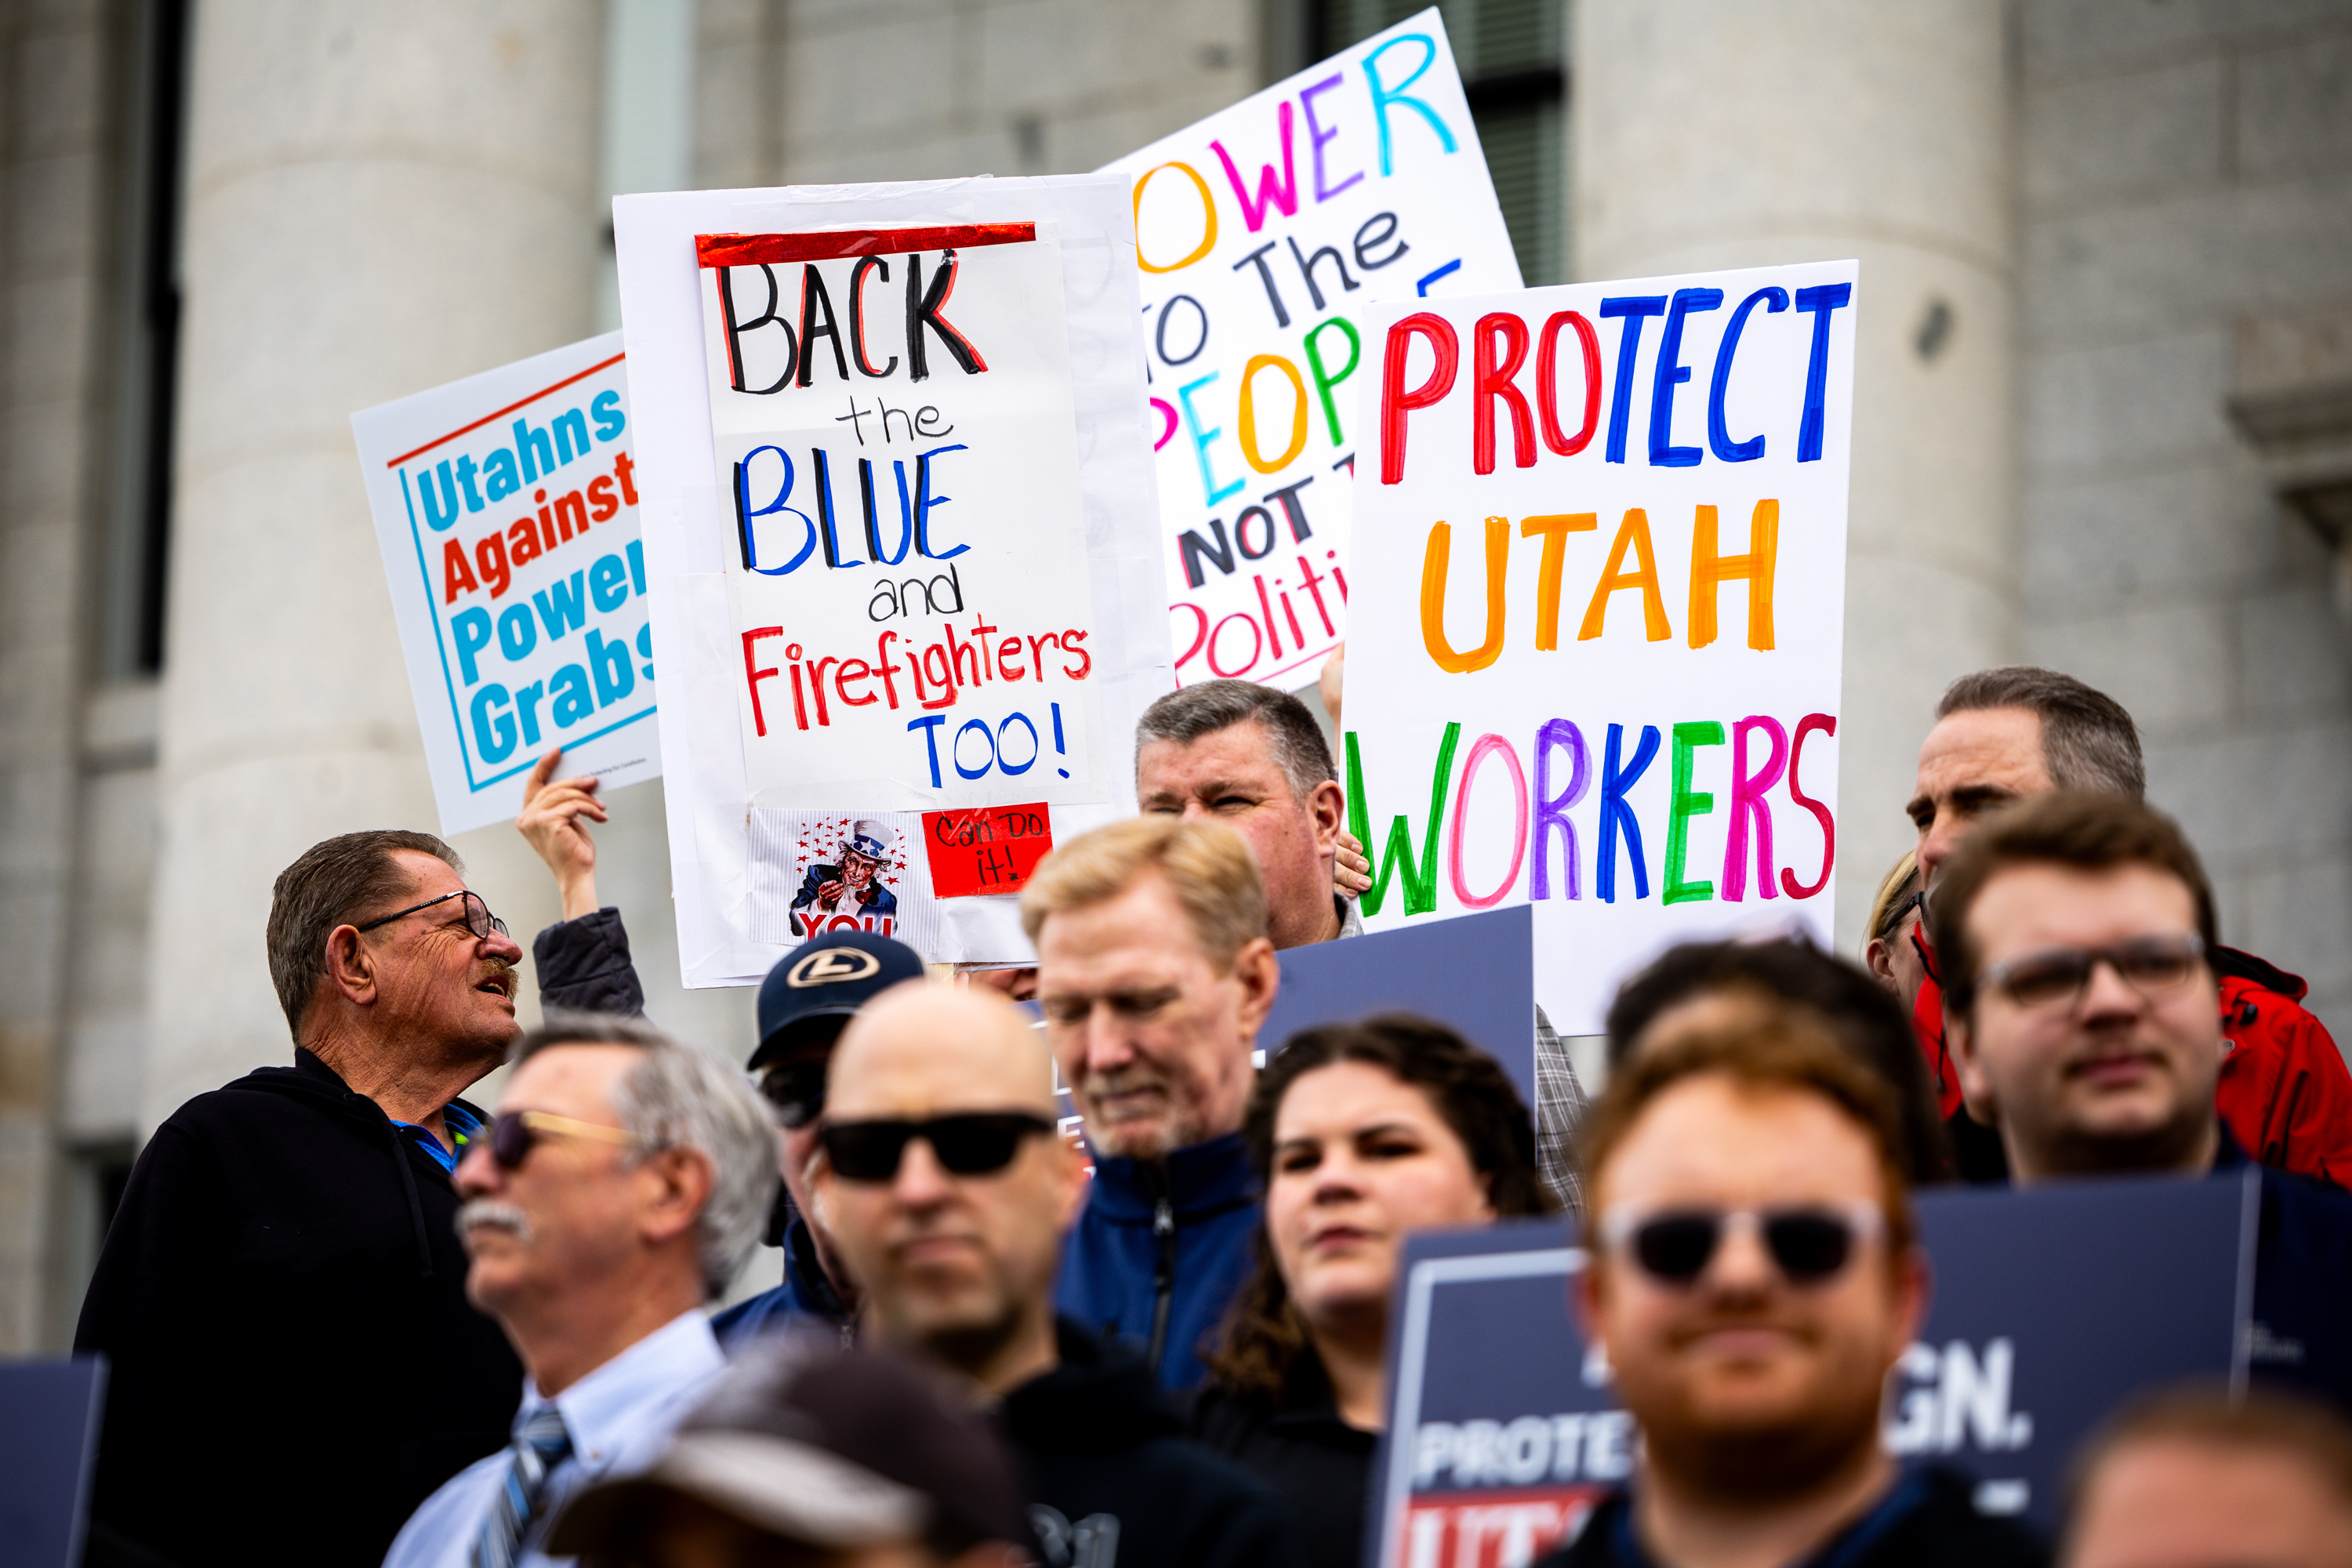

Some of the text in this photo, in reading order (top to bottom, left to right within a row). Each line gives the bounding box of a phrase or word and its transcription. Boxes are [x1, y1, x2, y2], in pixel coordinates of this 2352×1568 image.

[1132, 33, 1460, 274] OWER
[715, 249, 989, 395] BACK
[1142, 211, 1410, 385] O The
[835, 395, 954, 446] the
[1381, 282, 1853, 485] PROTECT
[416, 389, 626, 532] Utahns
[444, 451, 639, 606] Against
[733, 444, 971, 575] BLUE
[869, 563, 964, 622] and
[1177, 475, 1314, 590] NOT
[1420, 498, 1780, 674] UTAH
[450, 539, 648, 688] Power
[742, 612, 1092, 737] Firefighters
[1169, 550, 1348, 691] Politi
[935, 815, 994, 848] Can
[975, 844, 1020, 886] it!
[1345, 713, 1838, 919] WORKERS
